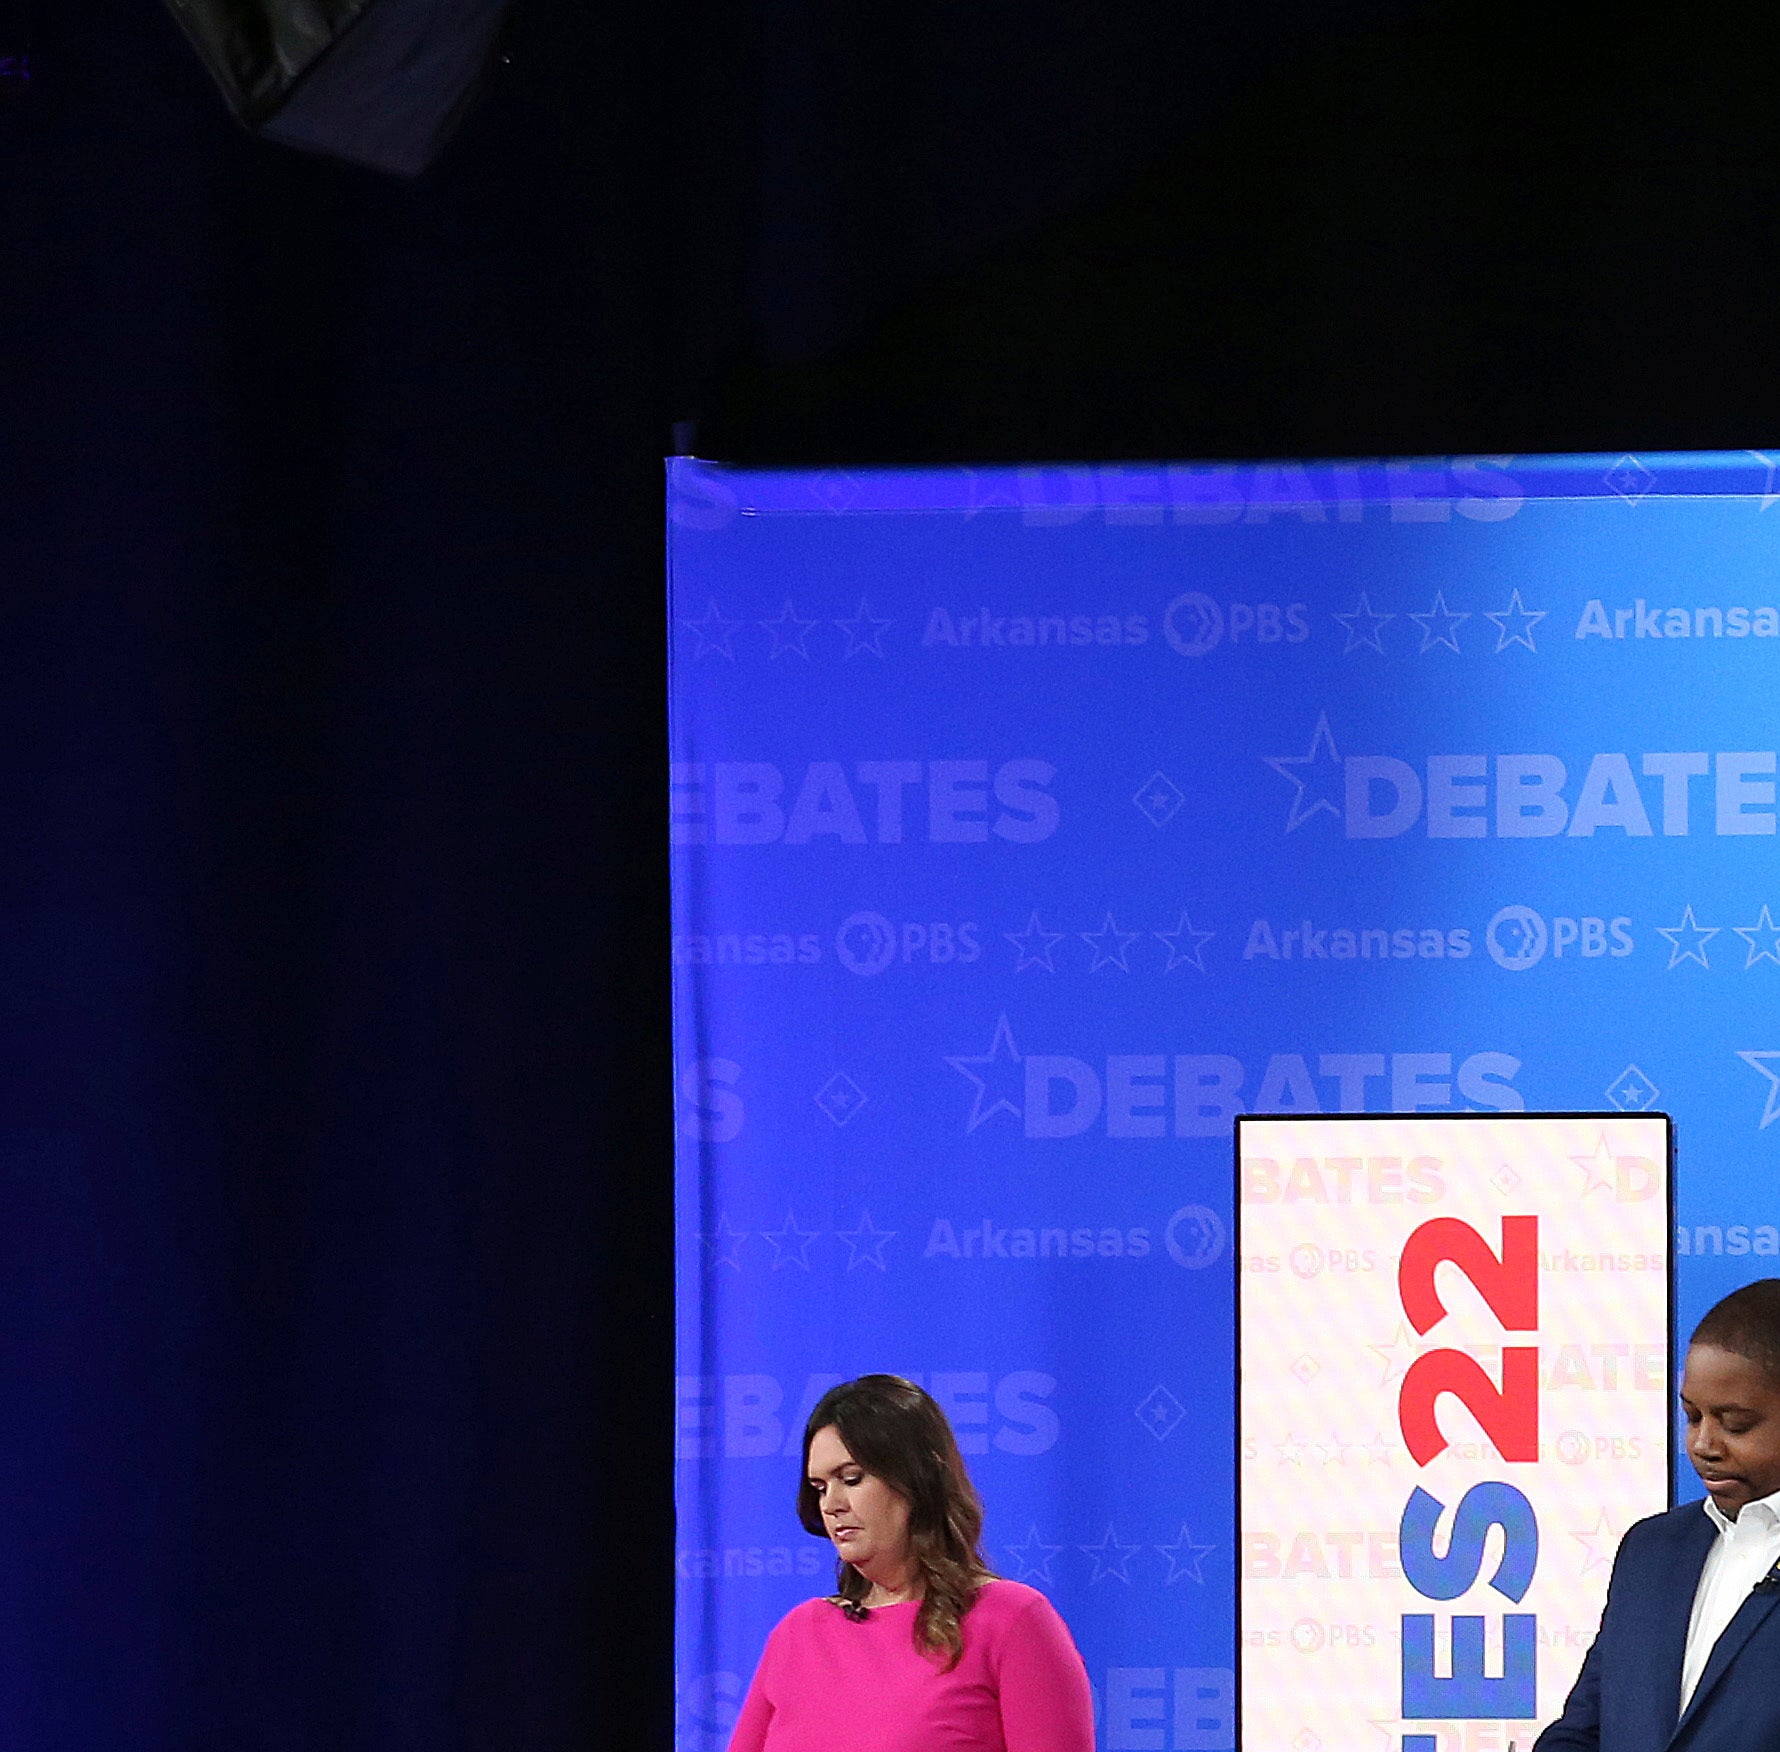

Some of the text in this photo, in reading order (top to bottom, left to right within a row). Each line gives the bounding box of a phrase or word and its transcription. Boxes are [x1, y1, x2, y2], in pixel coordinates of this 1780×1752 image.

[1023, 455, 1524, 528] DEBATES
[923, 603, 1310, 649] Arkansas PBS
[670, 759, 1060, 846] EBATES
[902, 922, 981, 964] PBS
[1243, 916, 1633, 961] Arkansas PBS
[1023, 1052, 1524, 1139] DEBATES
[1244, 1157, 1447, 1204] BATES
[925, 1218, 1149, 1259] Arkansas
[1328, 1249, 1376, 1273] PBS
[1594, 1437, 1642, 1461] PBS
[1329, 1624, 1376, 1647] PBS
